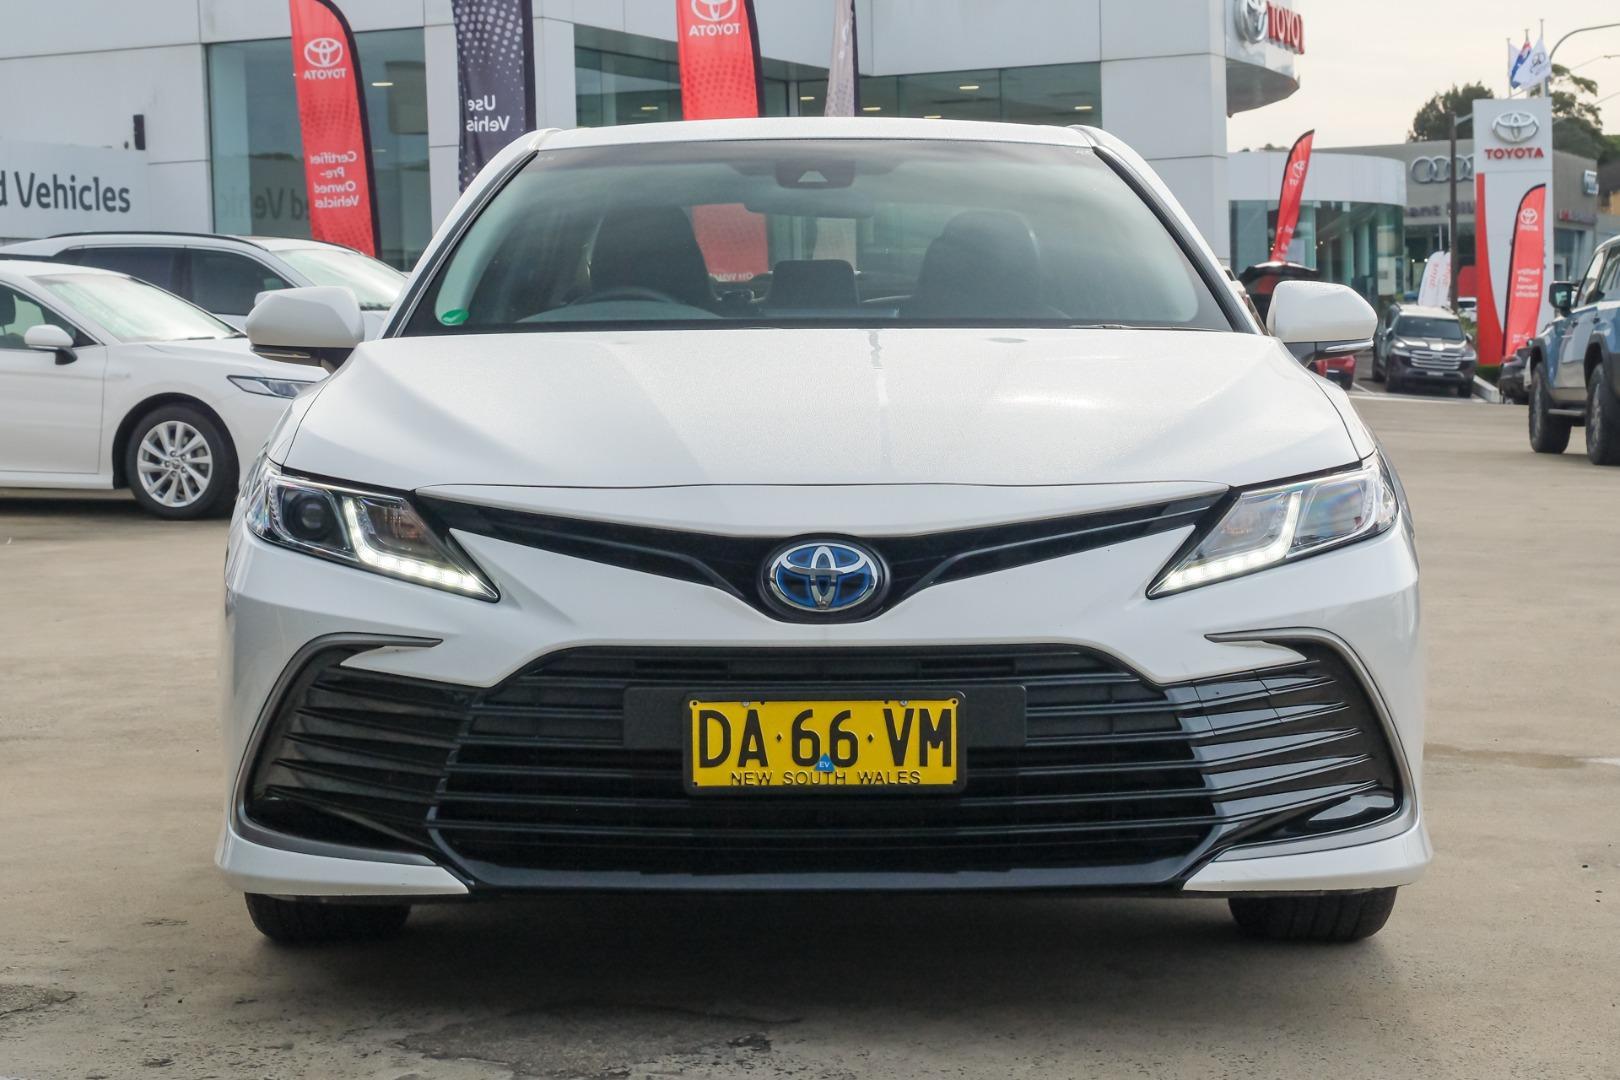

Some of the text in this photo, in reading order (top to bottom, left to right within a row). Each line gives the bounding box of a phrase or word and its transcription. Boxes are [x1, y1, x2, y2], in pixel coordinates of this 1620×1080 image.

[1484, 147, 1545, 160] TOYOTA
[14, 171, 131, 213] Vehicles
[731, 770, 921, 786] NEW SOUTH WALES
